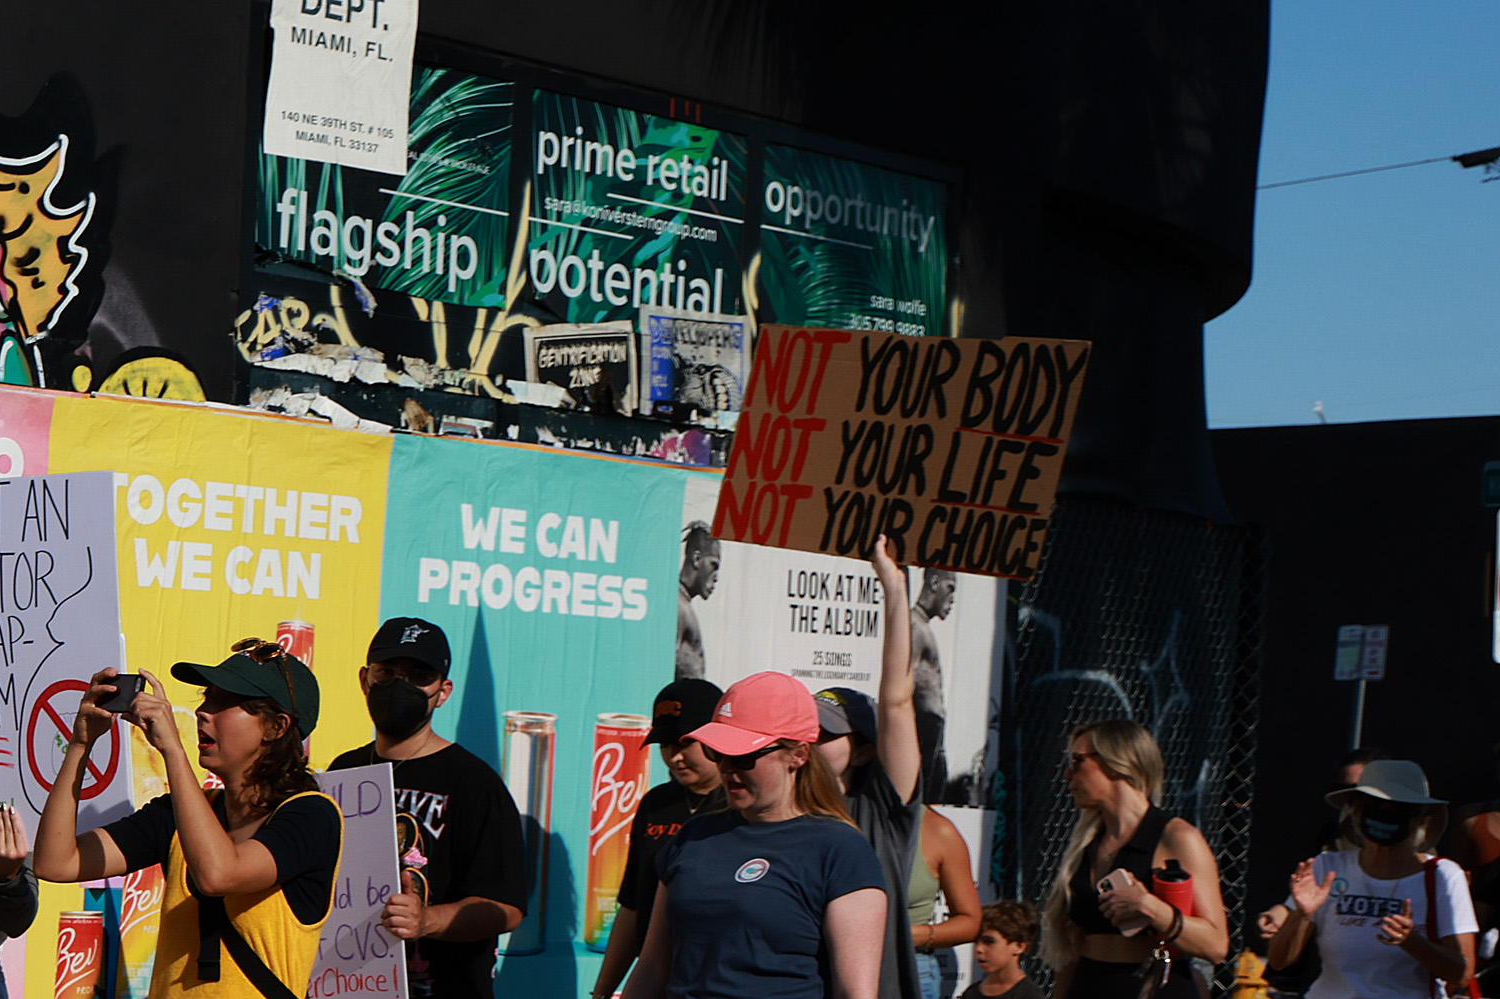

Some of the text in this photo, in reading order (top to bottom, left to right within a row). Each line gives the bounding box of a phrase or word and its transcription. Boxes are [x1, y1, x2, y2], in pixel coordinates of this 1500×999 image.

[291, 26, 393, 62] MIAMI, FL.
[301, 0, 389, 31] DEPT.
[281, 110, 394, 139] 140 NE 39TH ST. # 105
[295, 130, 379, 153] MIAMI, FL 33137
[537, 126, 636, 181] prime
[646, 154, 728, 201] retail
[276, 187, 478, 293] flagship
[765, 181, 935, 252] opportunity
[870, 295, 895, 311] sara
[538, 341, 627, 369] GENTRIFICATION
[745, 328, 1089, 440] NOT YOUR BODY
[726, 410, 1060, 512] NOT YOUR LIFE
[22, 479, 70, 542] AN
[461, 503, 619, 564] WE CAN
[712, 480, 1048, 577] NOT YOUR CHOICE
[133, 537, 322, 600] WE CAN
[418, 557, 648, 621] PROGRESS
[787, 569, 855, 602] LOOK AT
[789, 604, 878, 638] THE ALBUM
[334, 921, 394, 962] CVS.
